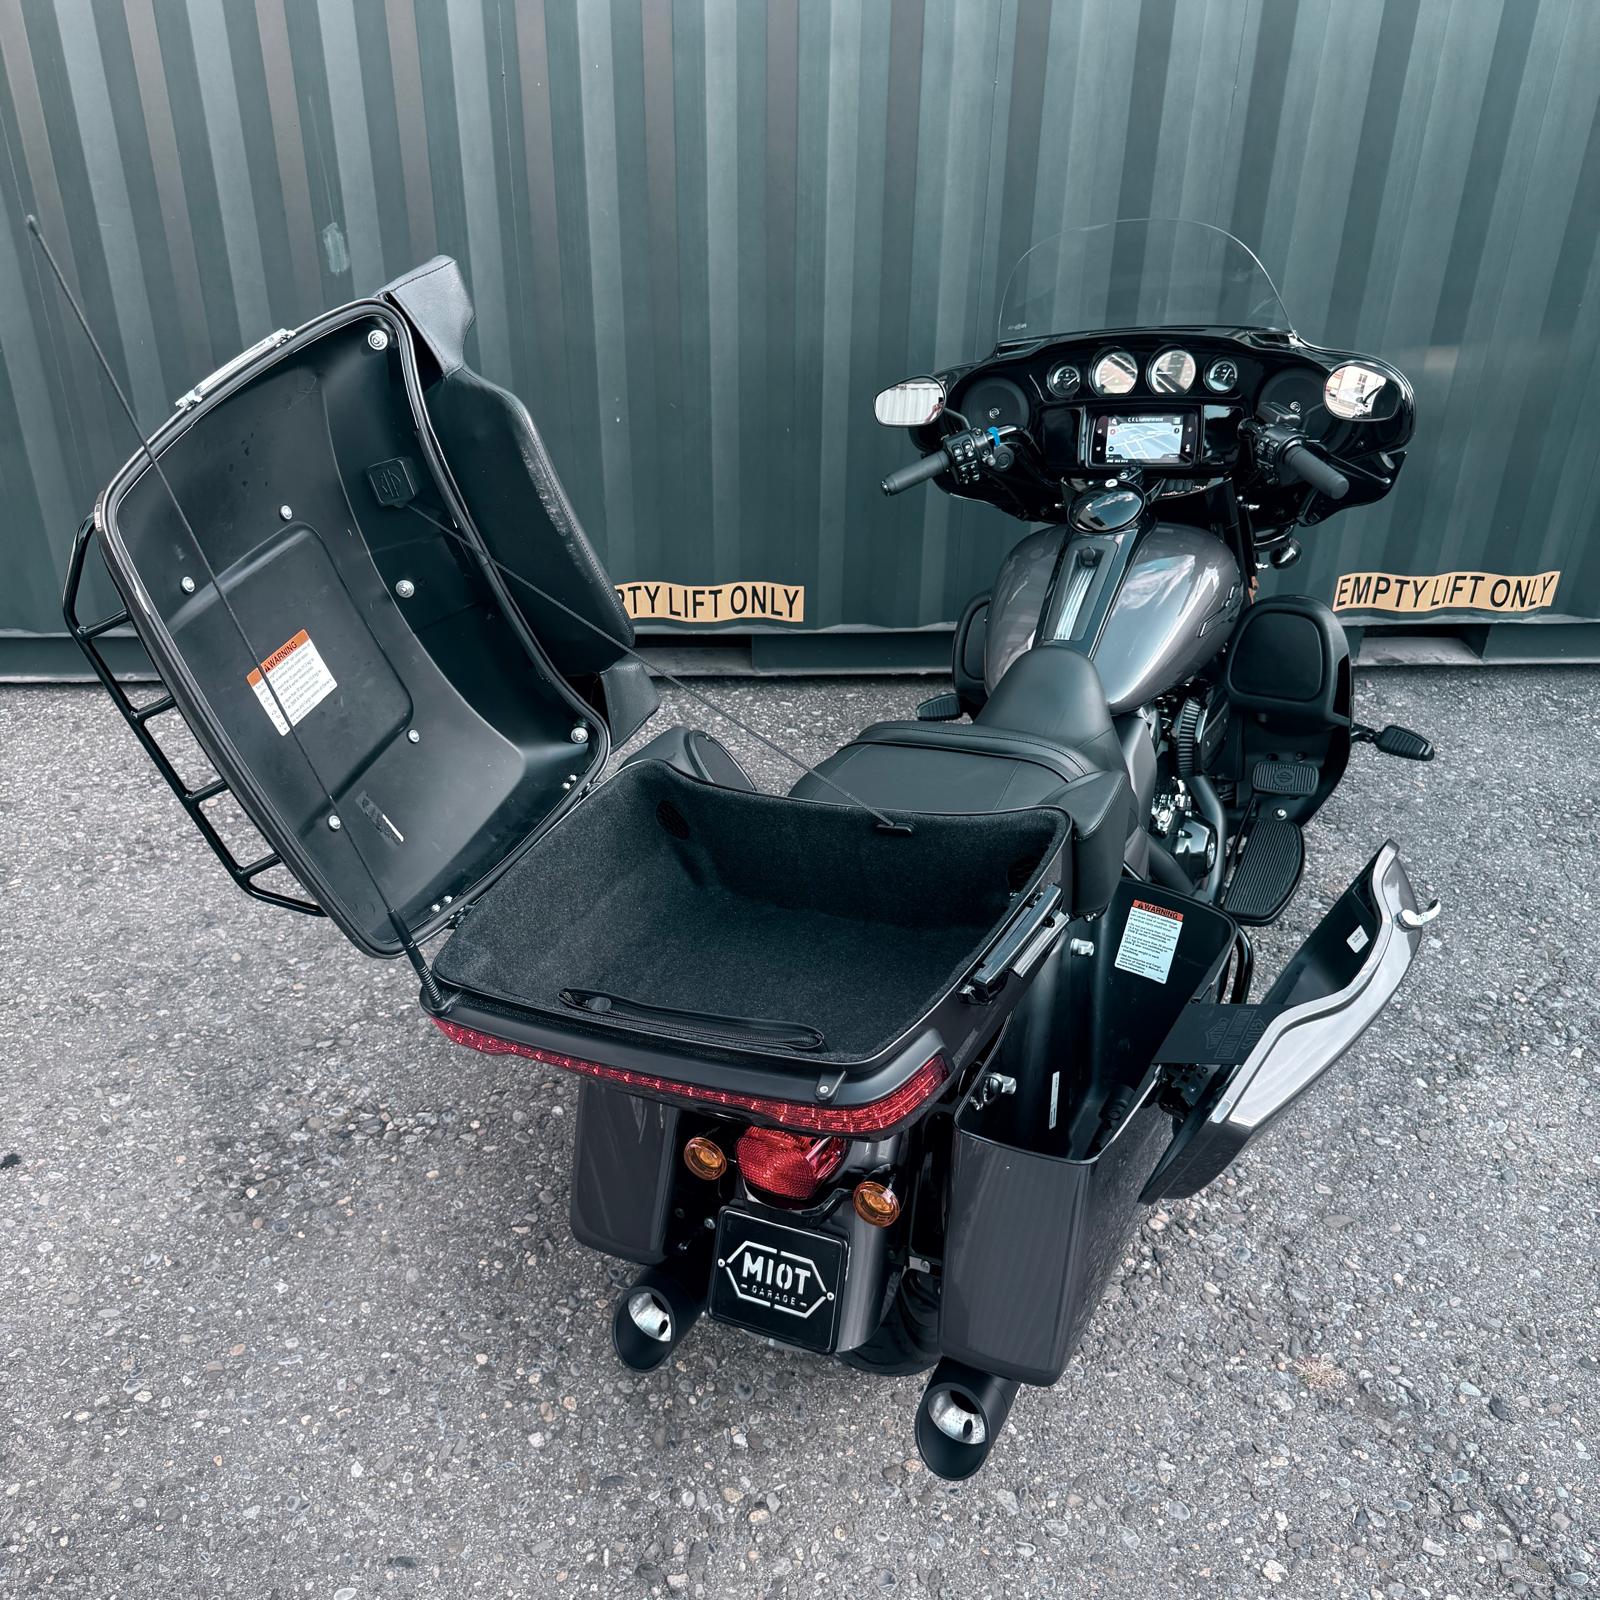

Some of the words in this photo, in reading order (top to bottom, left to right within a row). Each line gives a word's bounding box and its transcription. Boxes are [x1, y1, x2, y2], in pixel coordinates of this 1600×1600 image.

[669, 587, 723, 618] LIFT
[730, 585, 800, 618] ONLY
[1336, 576, 1428, 608] EMPTY
[1430, 576, 1485, 607] LIFT
[1490, 575, 1555, 608] ONLY
[268, 641, 298, 669] WARNING
[1144, 903, 1178, 919] WARNING
[742, 1252, 811, 1294] MIOT
[751, 1285, 796, 1305] GARAGE
